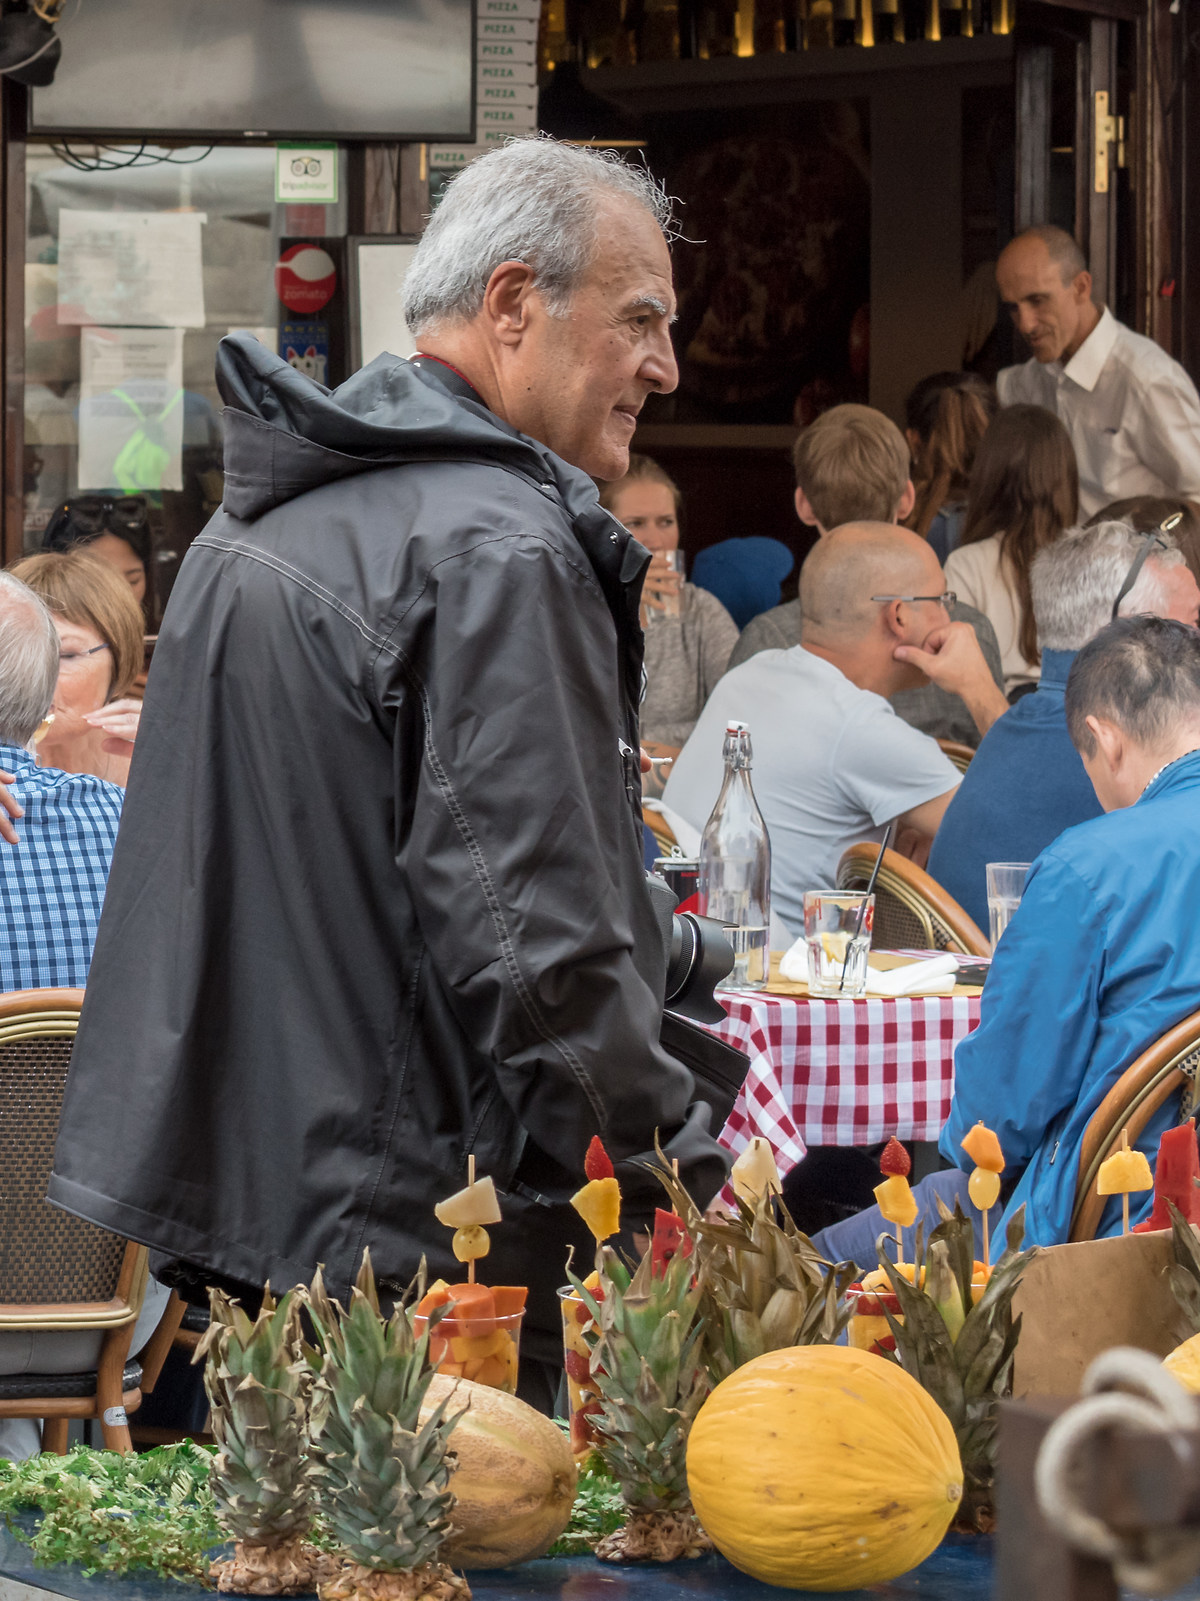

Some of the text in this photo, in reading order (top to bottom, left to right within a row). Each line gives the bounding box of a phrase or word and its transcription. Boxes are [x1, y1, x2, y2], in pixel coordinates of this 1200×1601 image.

[487, 2, 518, 11] PIZZA
[484, 25, 515, 33] PIZZA
[482, 46, 513, 55] PIZZA
[482, 68, 514, 77] PIZZA
[485, 89, 515, 98] PIZZA
[484, 111, 514, 120] PIZZA
[434, 153, 465, 161] PIZZA
